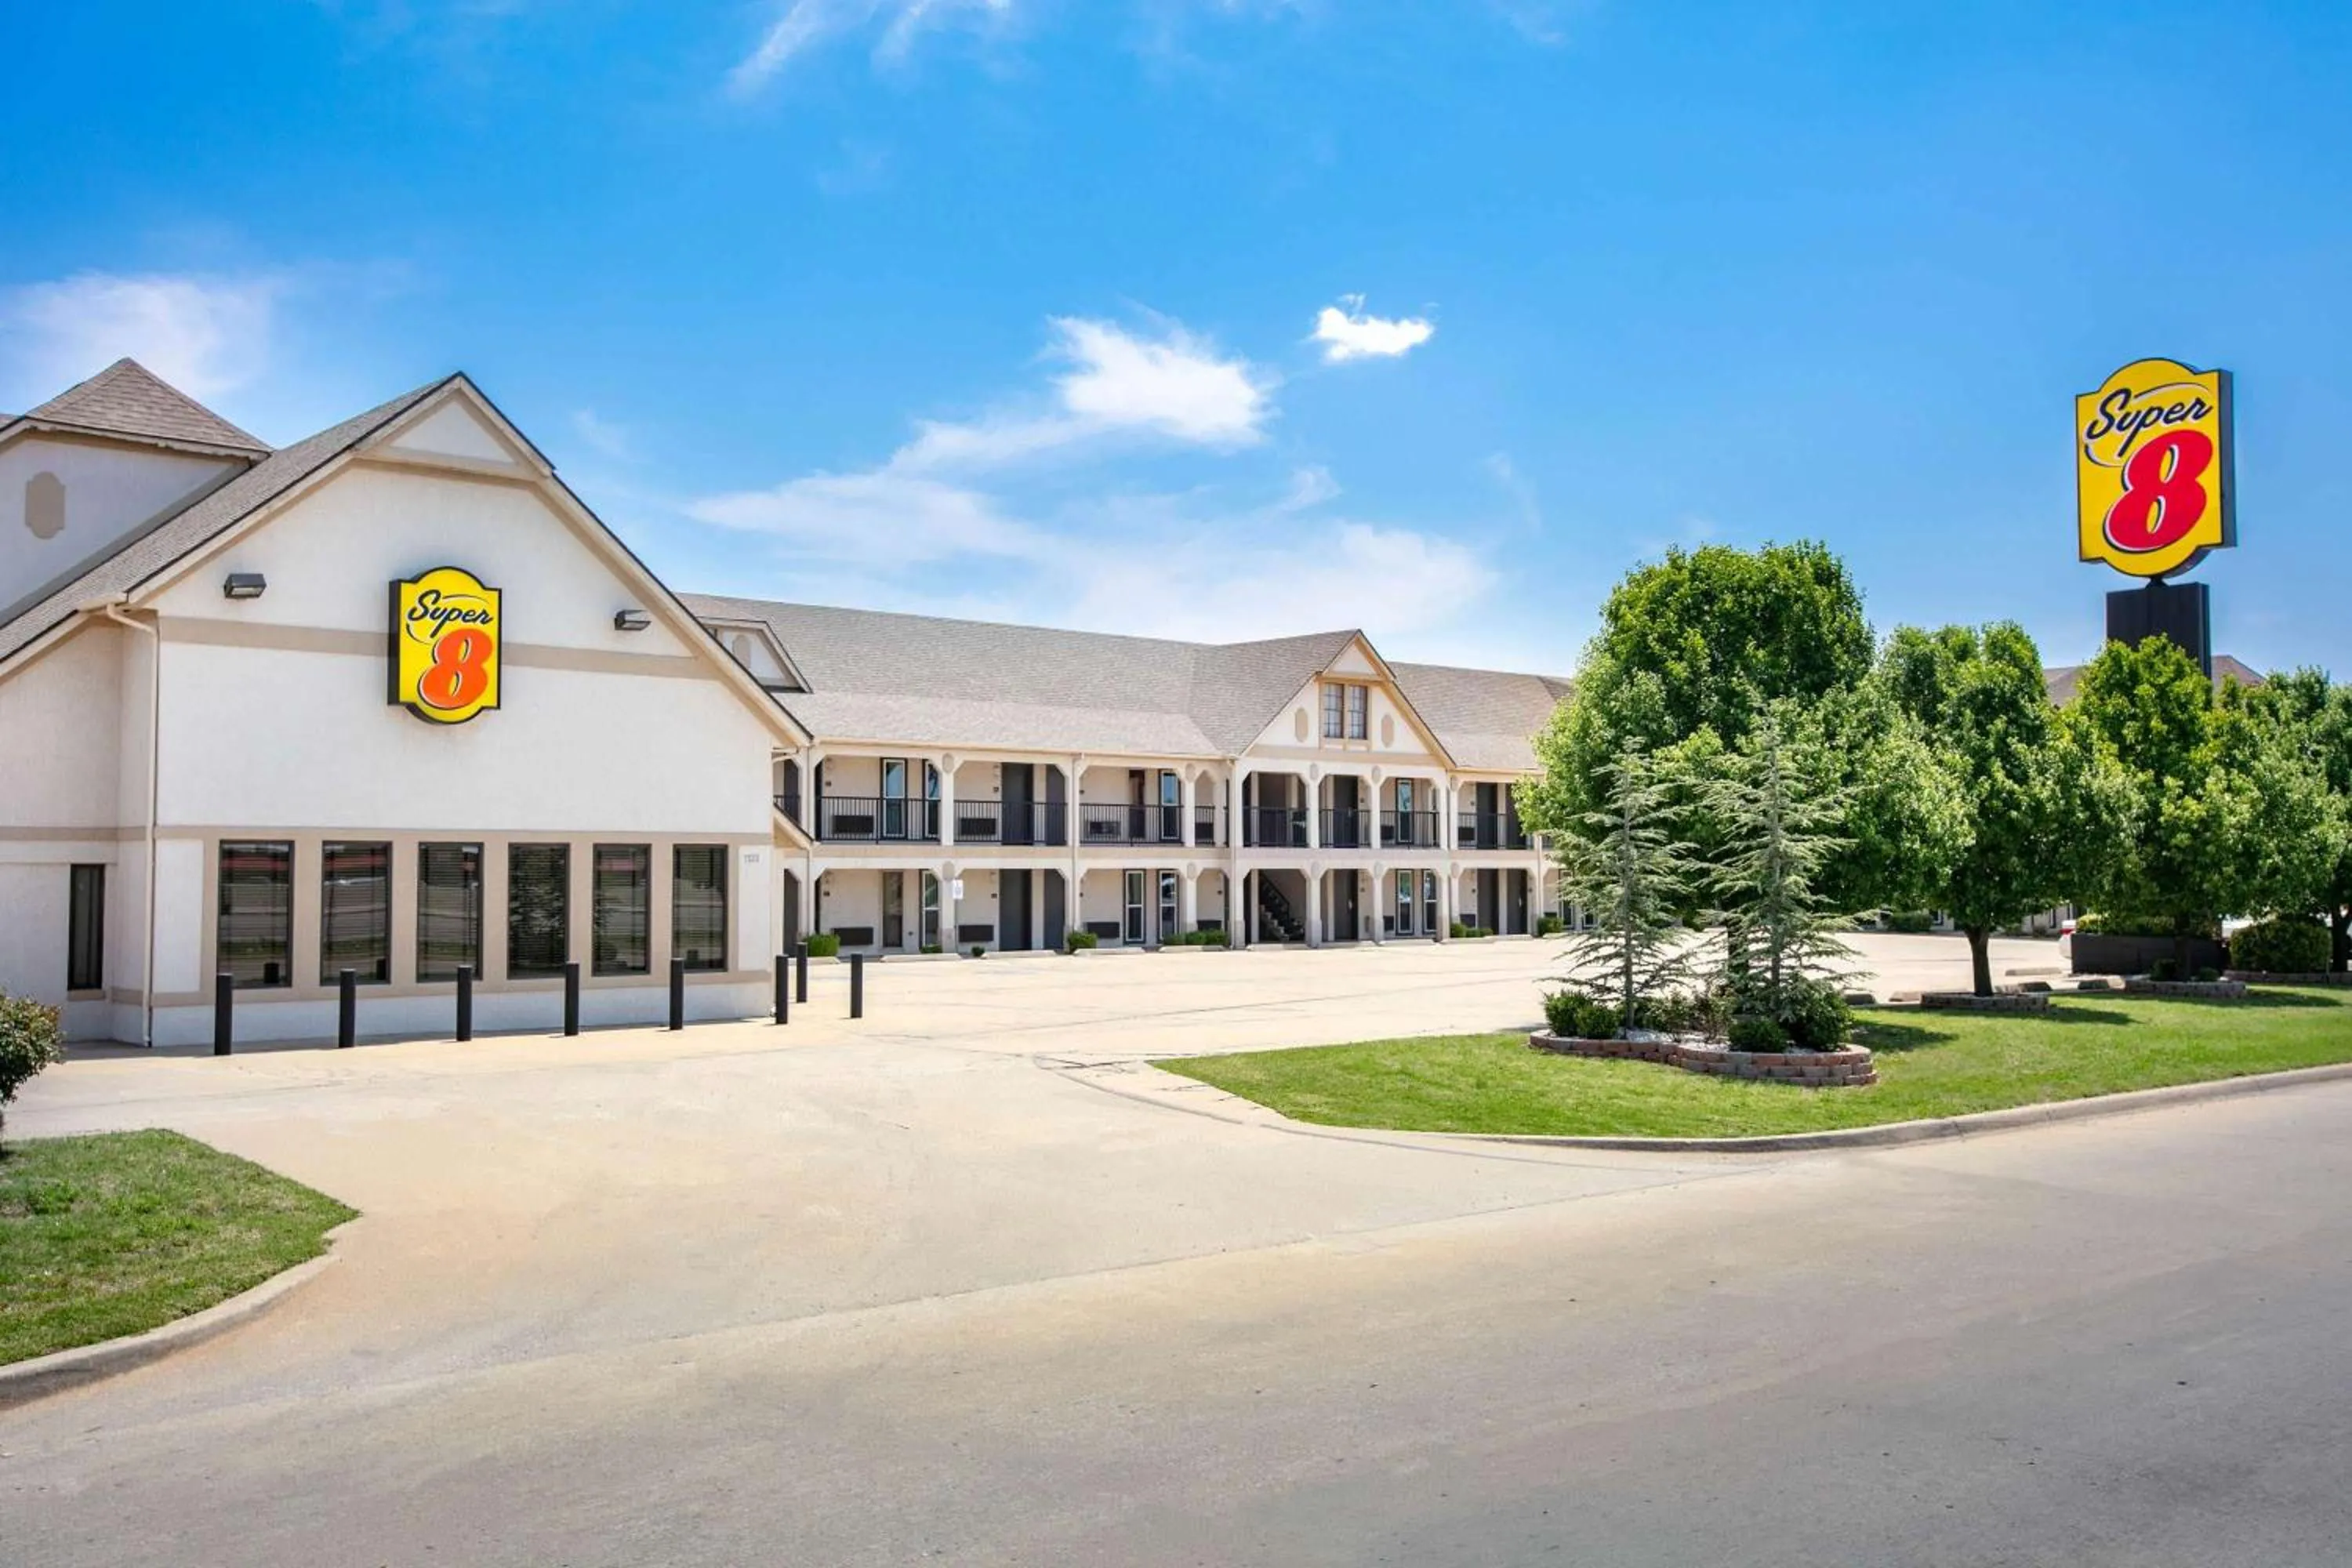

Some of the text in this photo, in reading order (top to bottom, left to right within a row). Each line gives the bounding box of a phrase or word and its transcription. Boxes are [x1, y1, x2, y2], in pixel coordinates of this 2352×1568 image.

[2085, 387, 2213, 458] Super
[2103, 429, 2213, 554] 8
[407, 589, 494, 639] Super
[417, 628, 493, 711] 8
